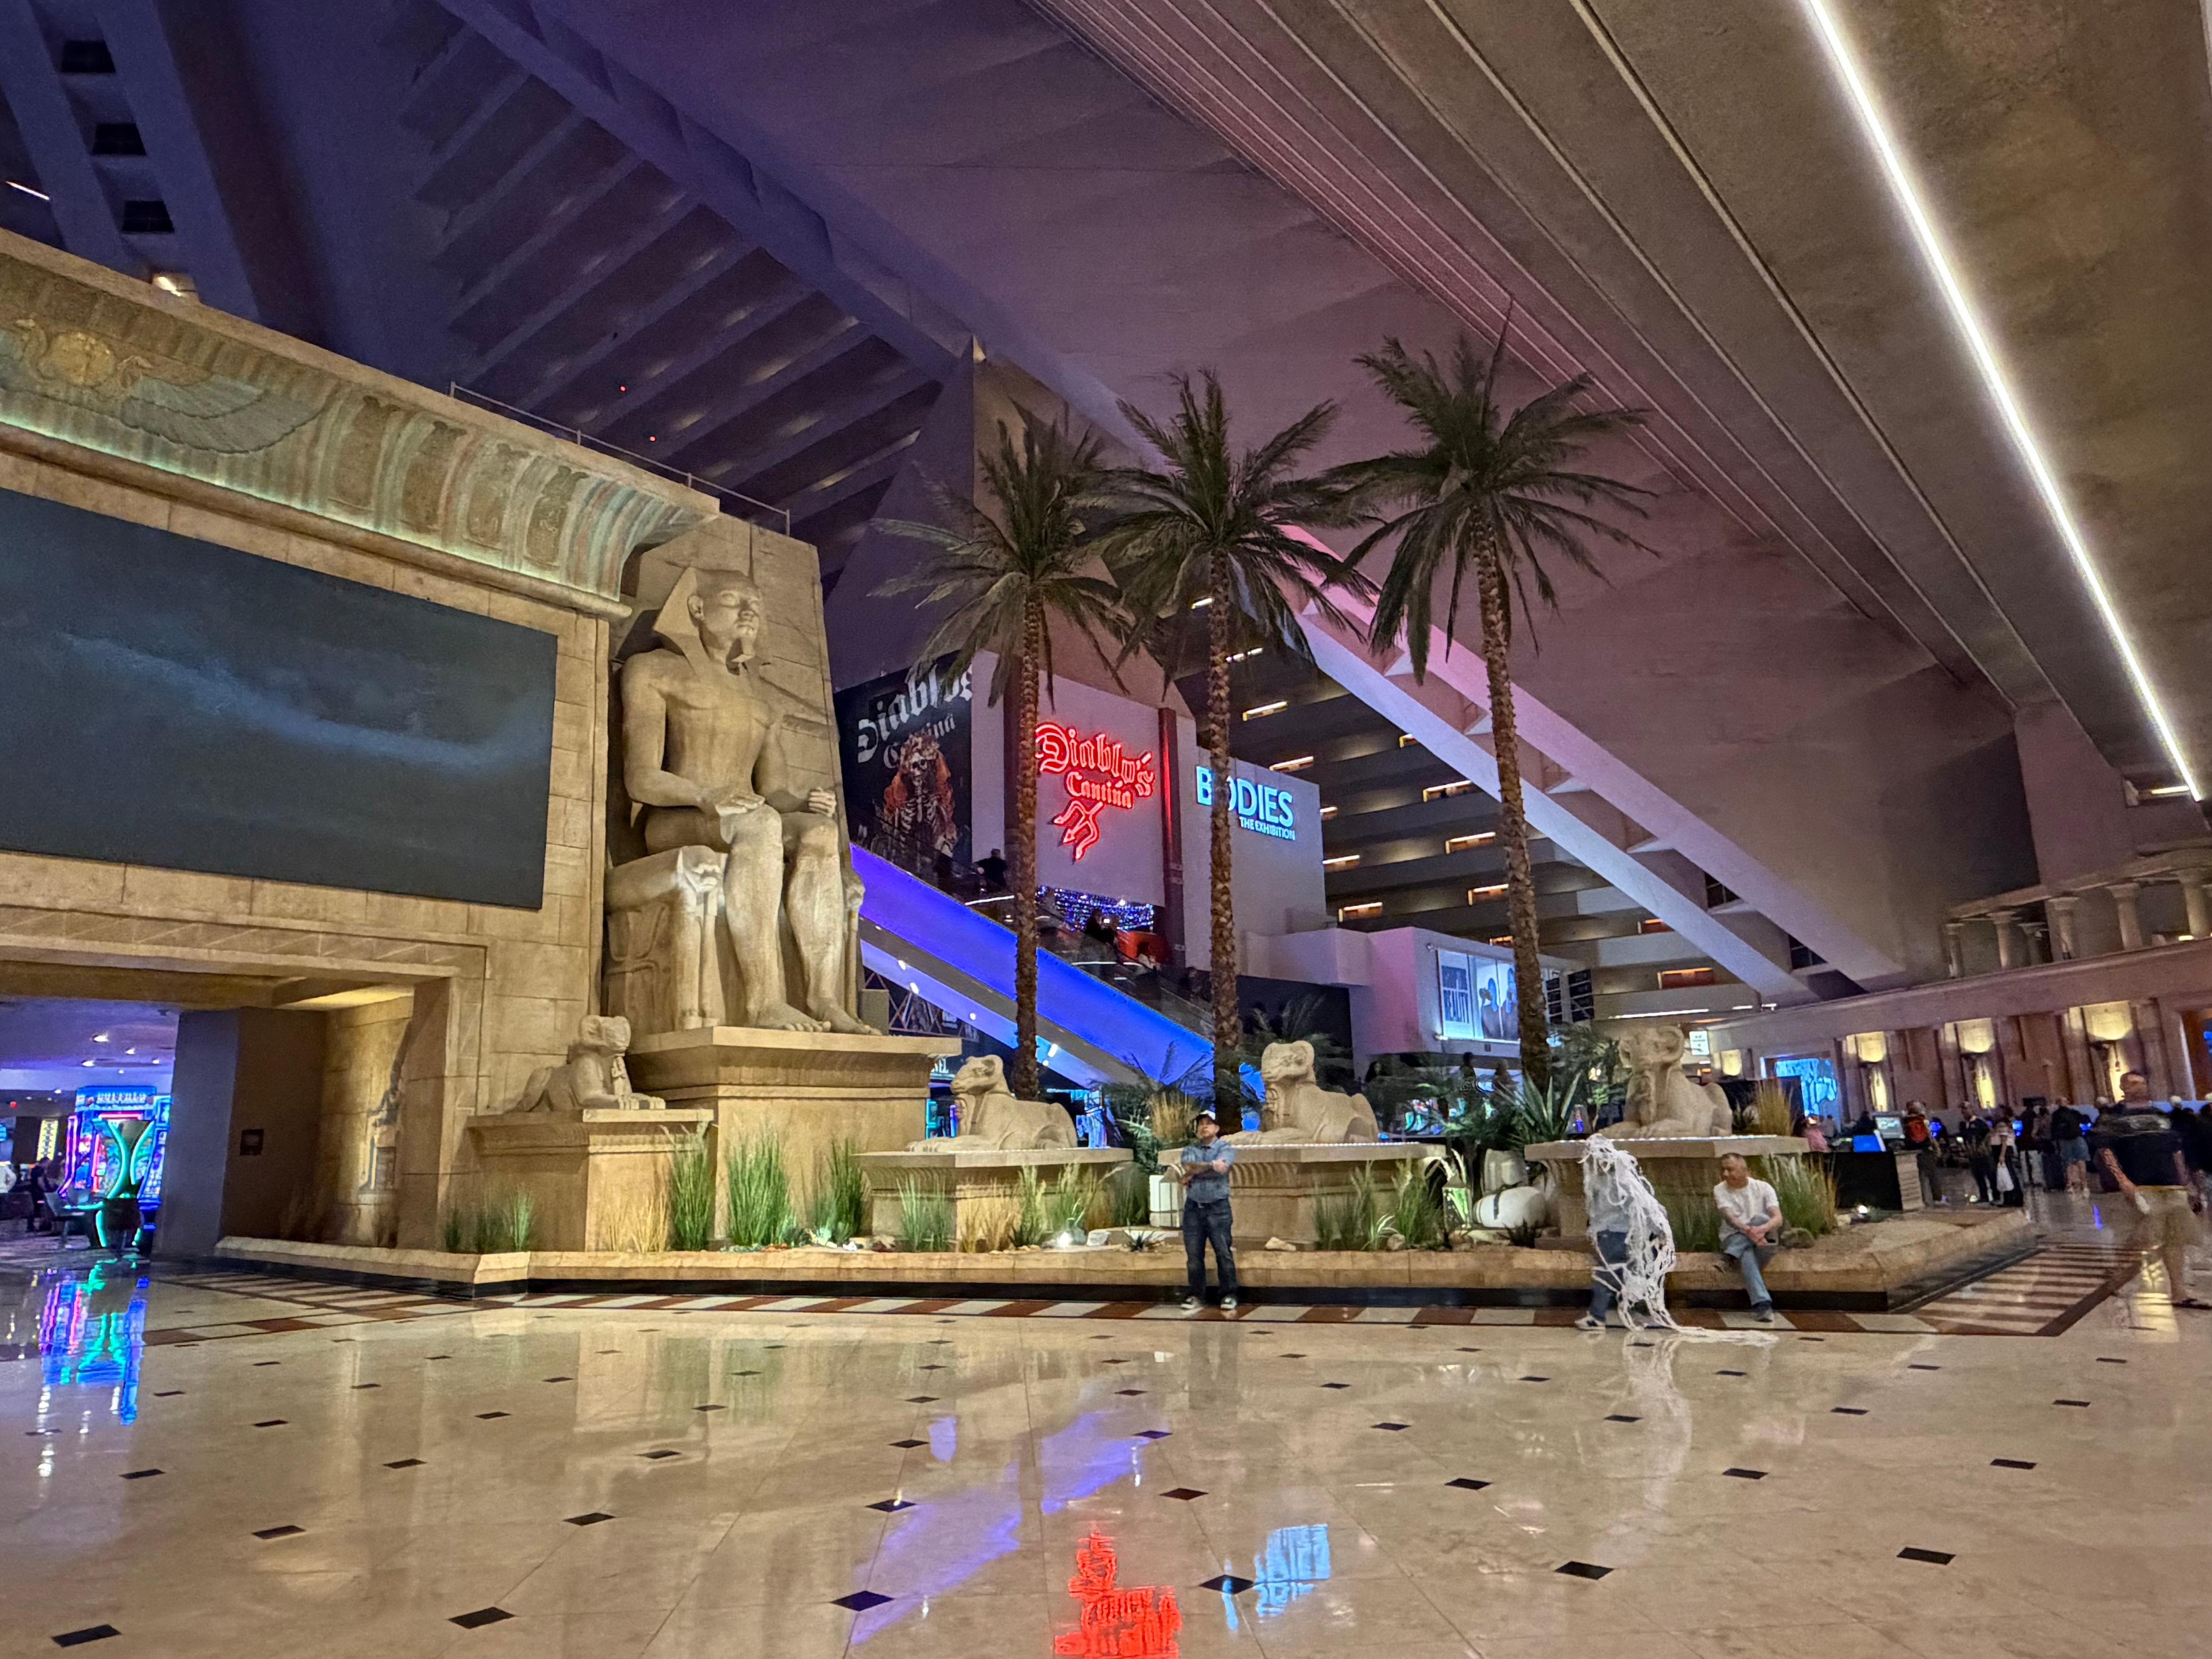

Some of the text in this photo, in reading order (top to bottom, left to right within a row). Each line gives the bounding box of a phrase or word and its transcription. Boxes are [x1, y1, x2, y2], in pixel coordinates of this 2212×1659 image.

[1035, 723, 1155, 797] Diablo's
[1239, 817, 1295, 841] THE EXHIBITION
